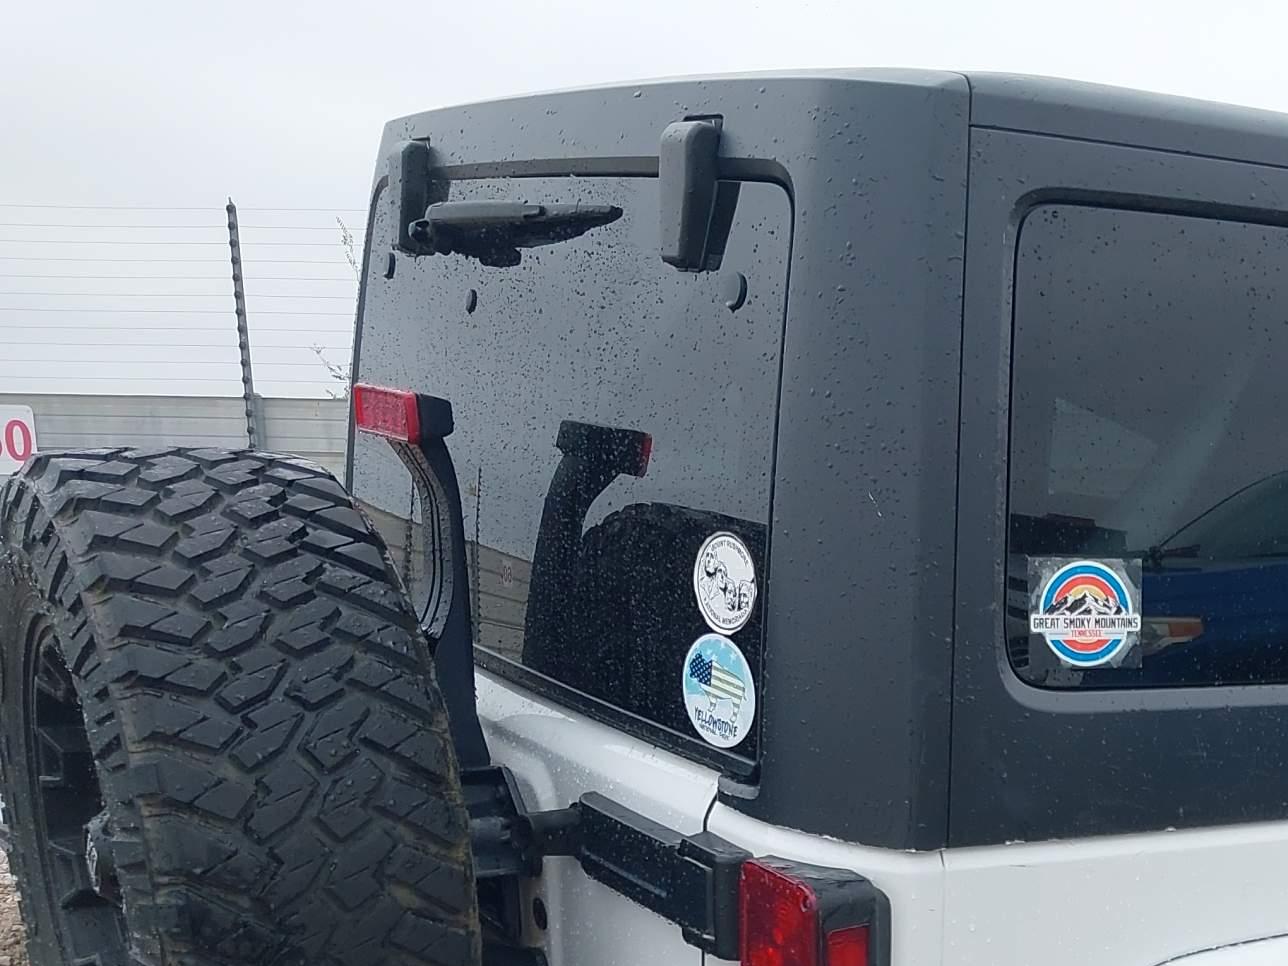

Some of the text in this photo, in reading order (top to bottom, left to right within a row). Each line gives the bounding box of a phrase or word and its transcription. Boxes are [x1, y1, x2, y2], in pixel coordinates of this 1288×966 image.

[0, 418, 32, 461] 0
[1033, 618, 1138, 629] GREAT SMOKY MOUNTAINS
[1071, 629, 1103, 638] TENNESSEE
[694, 706, 738, 738] YELLOWSTONE
